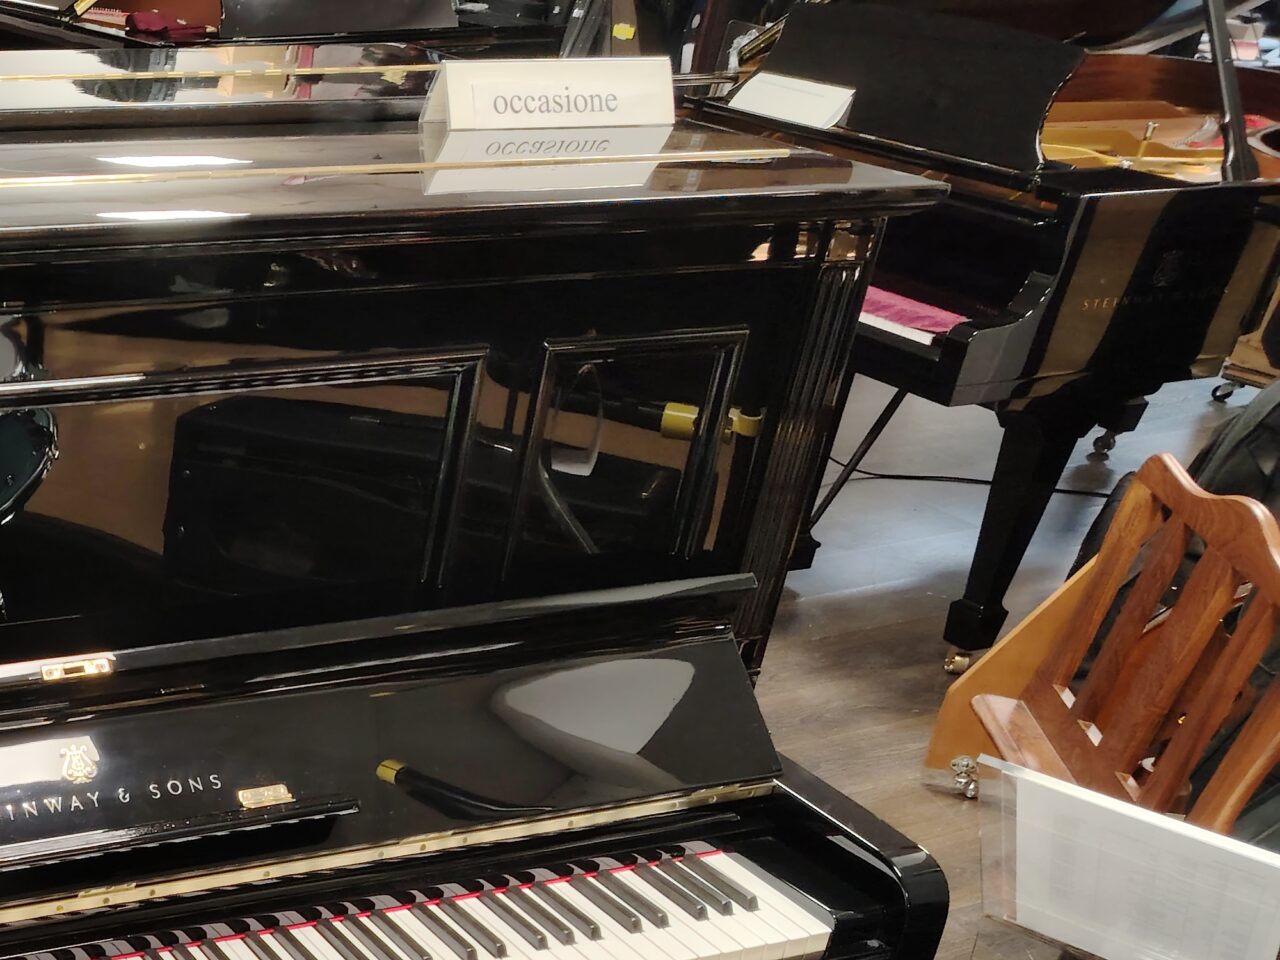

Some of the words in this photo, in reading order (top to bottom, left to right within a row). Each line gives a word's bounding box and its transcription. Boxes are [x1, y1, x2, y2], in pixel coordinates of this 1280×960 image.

[493, 86, 618, 115] occasione
[118, 787, 130, 803] &
[149, 774, 222, 799] SONS
